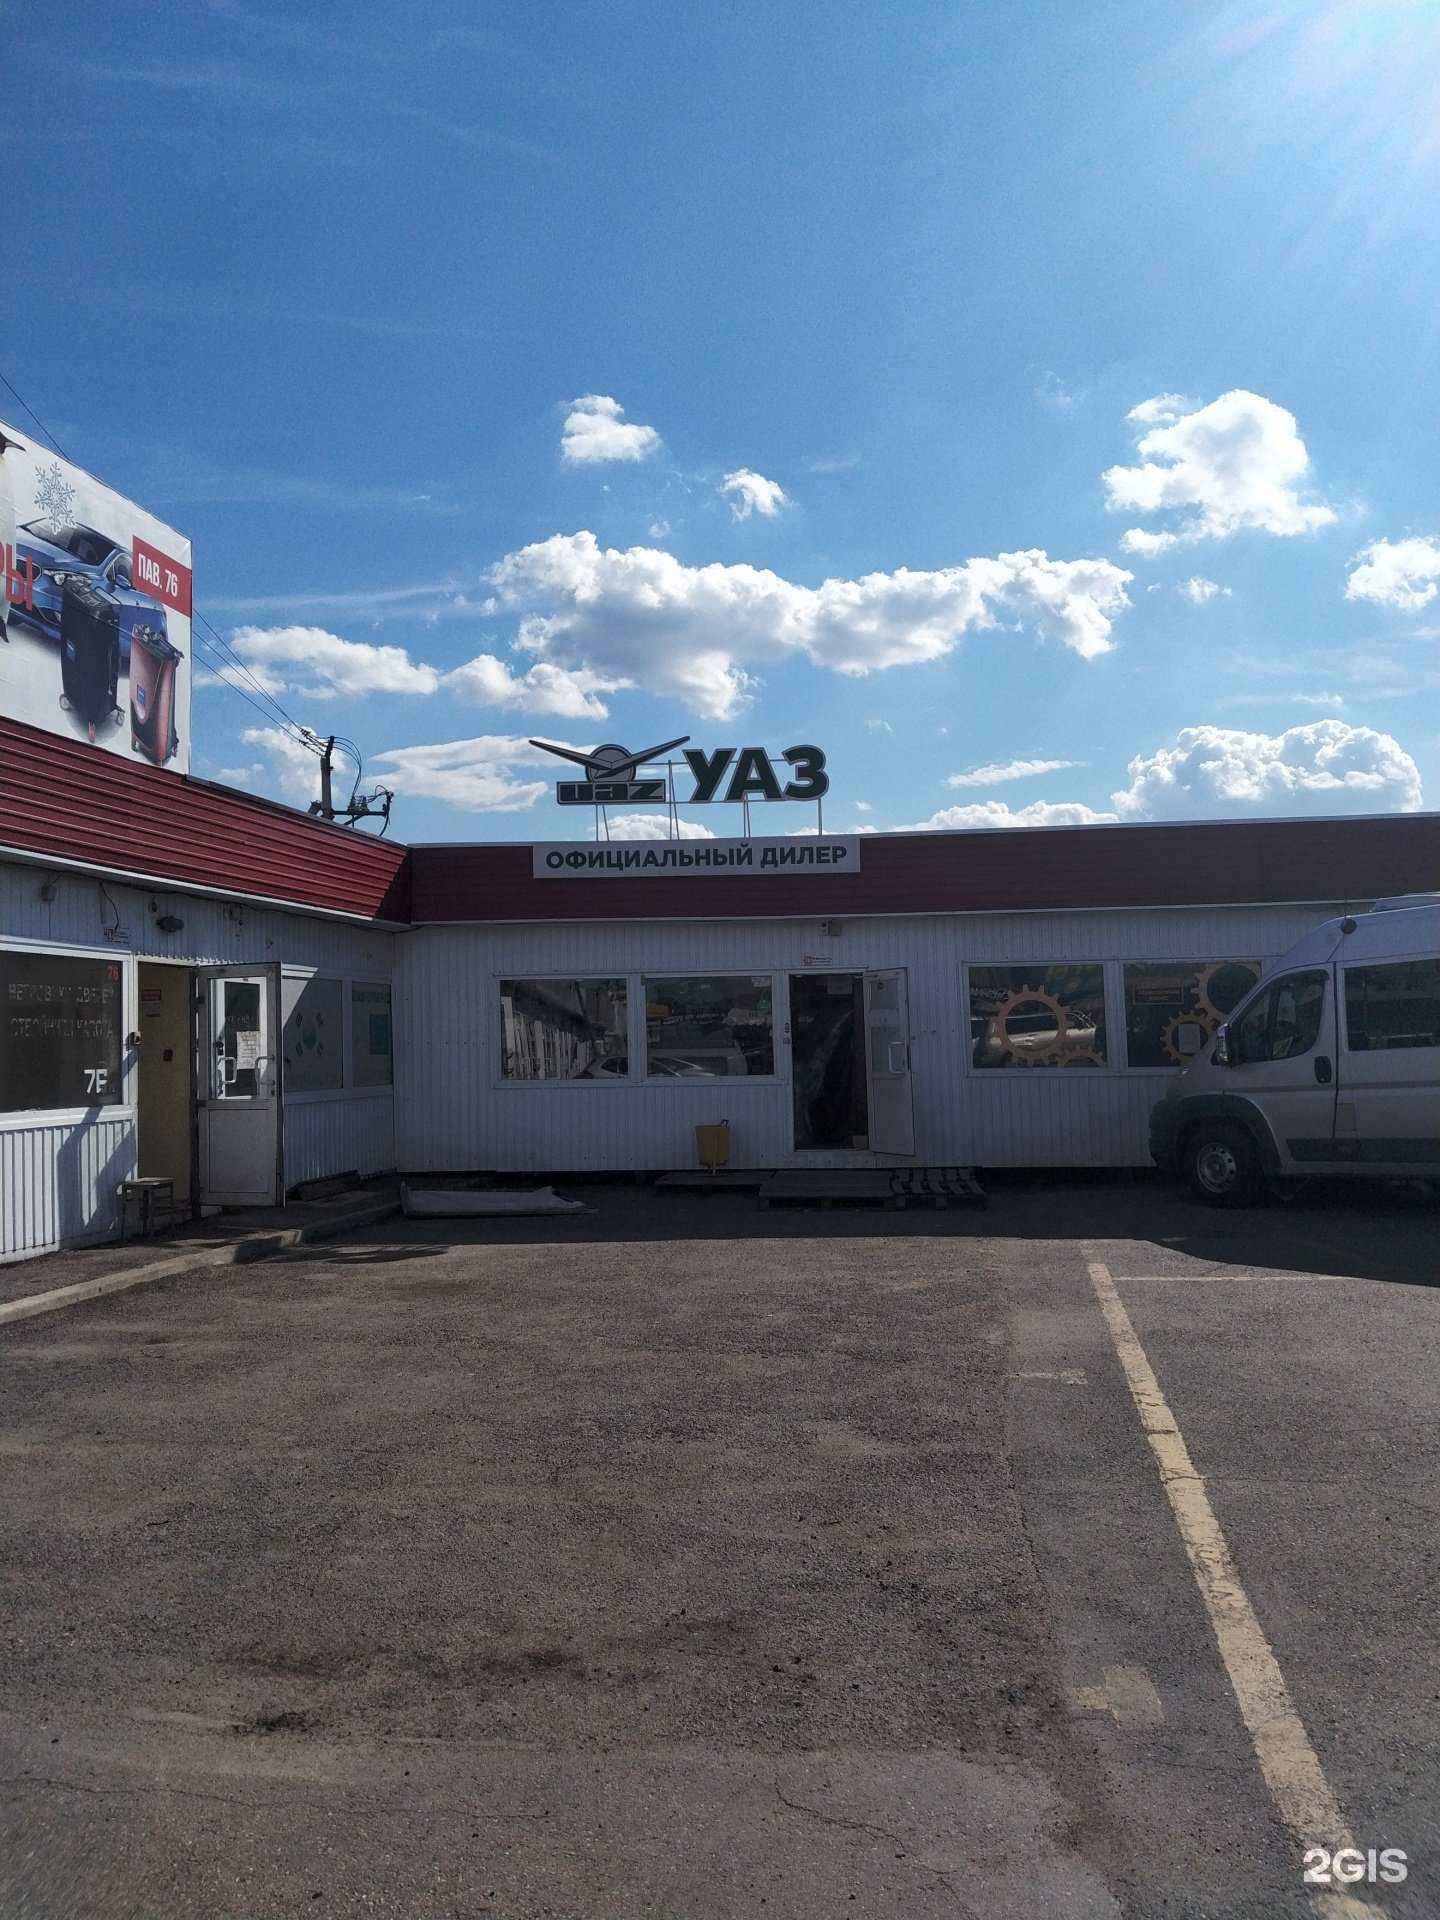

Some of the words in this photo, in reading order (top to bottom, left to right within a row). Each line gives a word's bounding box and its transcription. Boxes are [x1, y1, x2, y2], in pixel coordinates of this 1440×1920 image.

[138, 553, 163, 589] ПАВ.
[165, 569, 178, 597] 76
[682, 744, 831, 804] УАЗ
[545, 843, 753, 871] ОФИЦИАЛЬНЫЙ
[760, 845, 848, 868] ДИЛЕР
